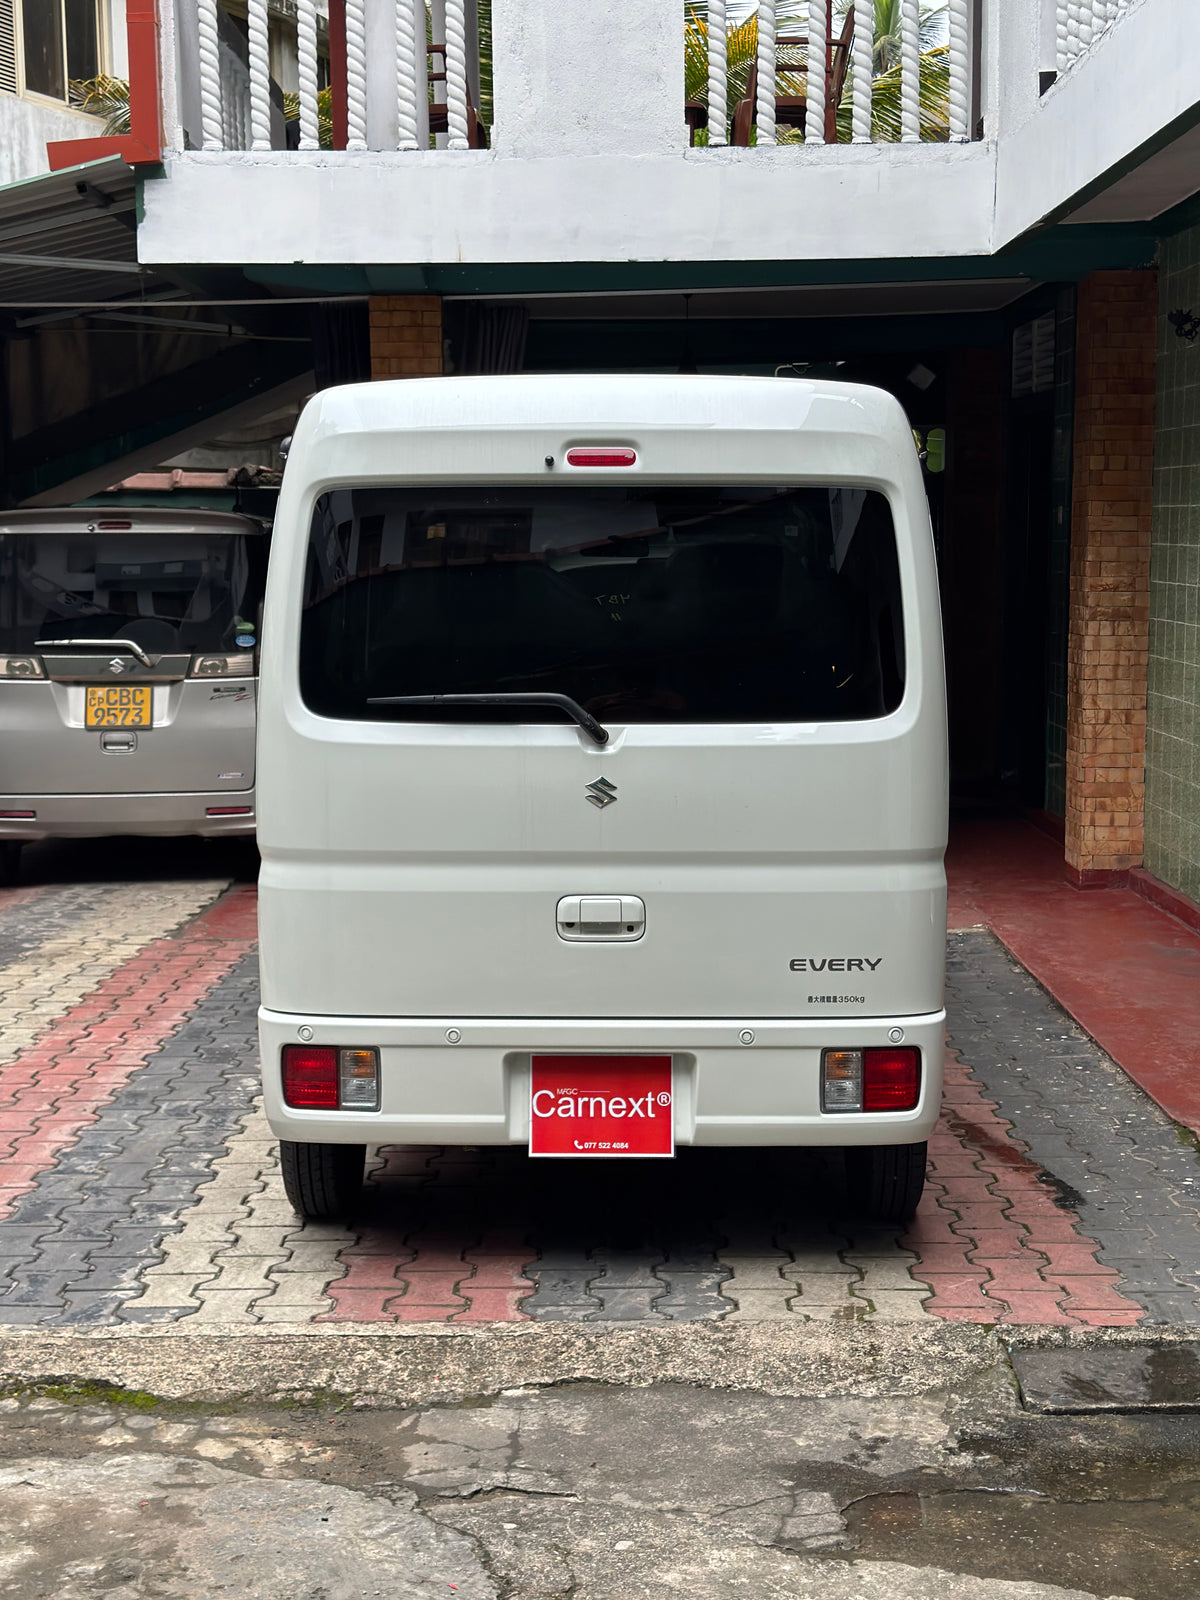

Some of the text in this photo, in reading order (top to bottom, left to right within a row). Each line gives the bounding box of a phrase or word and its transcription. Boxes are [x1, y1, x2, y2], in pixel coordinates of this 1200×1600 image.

[89, 688, 144, 707] CP CBC
[94, 707, 143, 726] 9573
[789, 958, 883, 971] EVERY
